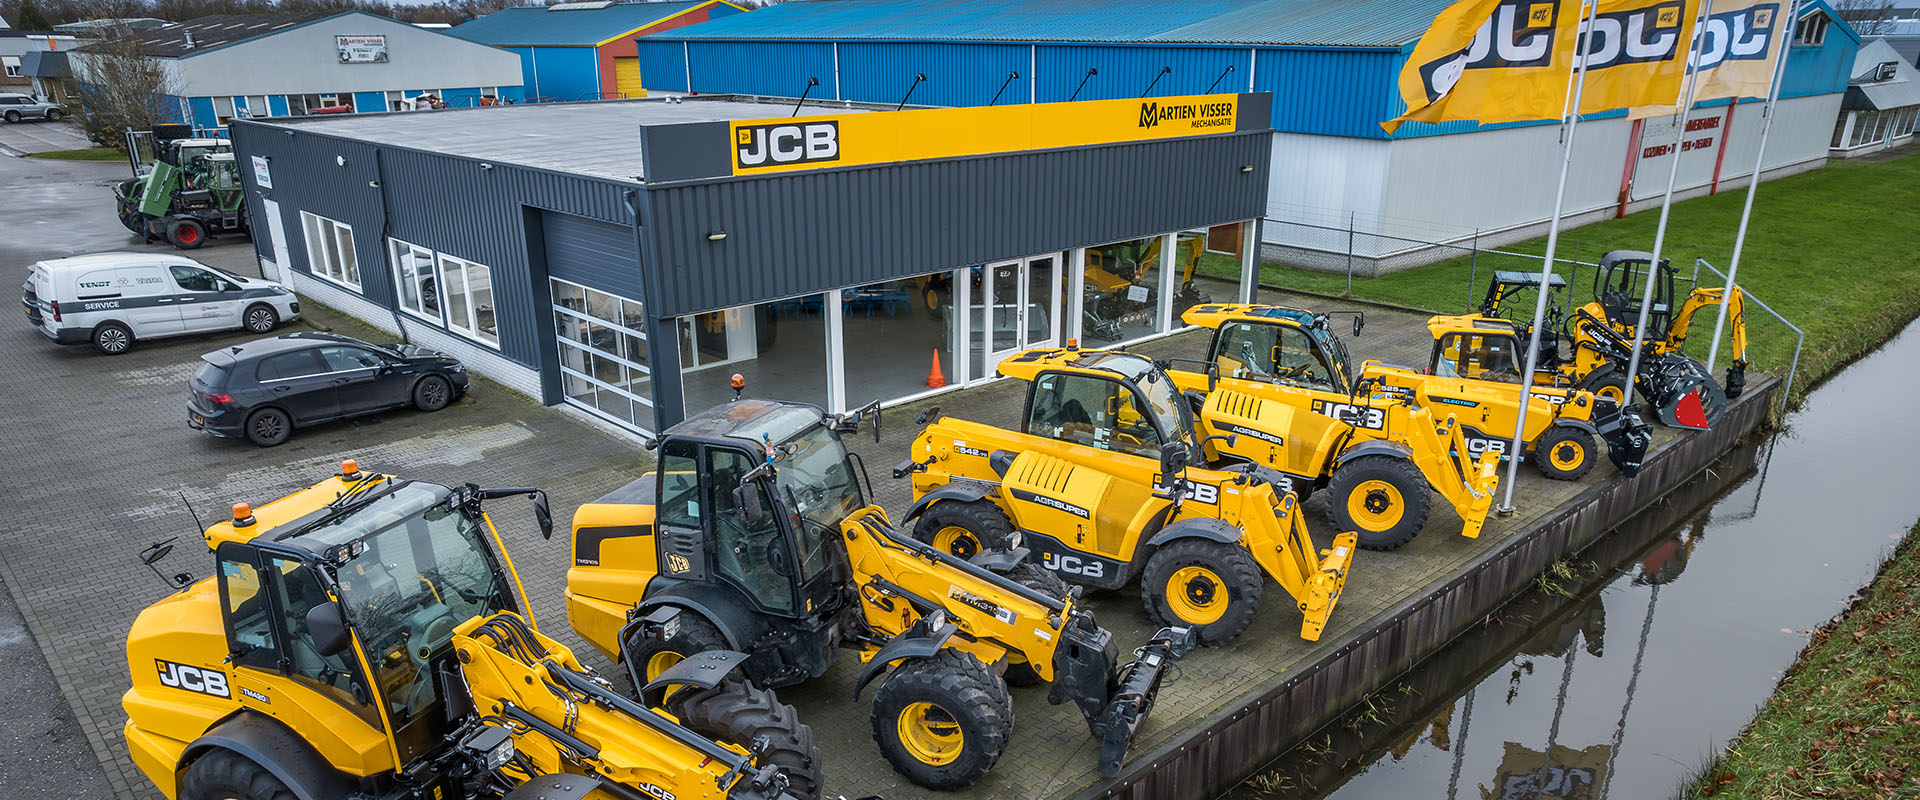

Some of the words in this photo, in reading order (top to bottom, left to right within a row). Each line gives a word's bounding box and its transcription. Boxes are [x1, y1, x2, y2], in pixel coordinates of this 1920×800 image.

[1139, 102, 1196, 129] MARTIEN
[1200, 102, 1232, 118] VISSER
[1191, 118, 1232, 128] MECHANISATIE
[740, 124, 838, 165] JCB
[80, 281, 111, 289] FENDT
[84, 301, 121, 310] SERVICE
[1232, 425, 1283, 445] AGRISUPER
[1033, 495, 1089, 518] AGRISUPER
[666, 553, 691, 574] JCB
[1043, 554, 1104, 578] JCB
[160, 663, 230, 697] JCB
